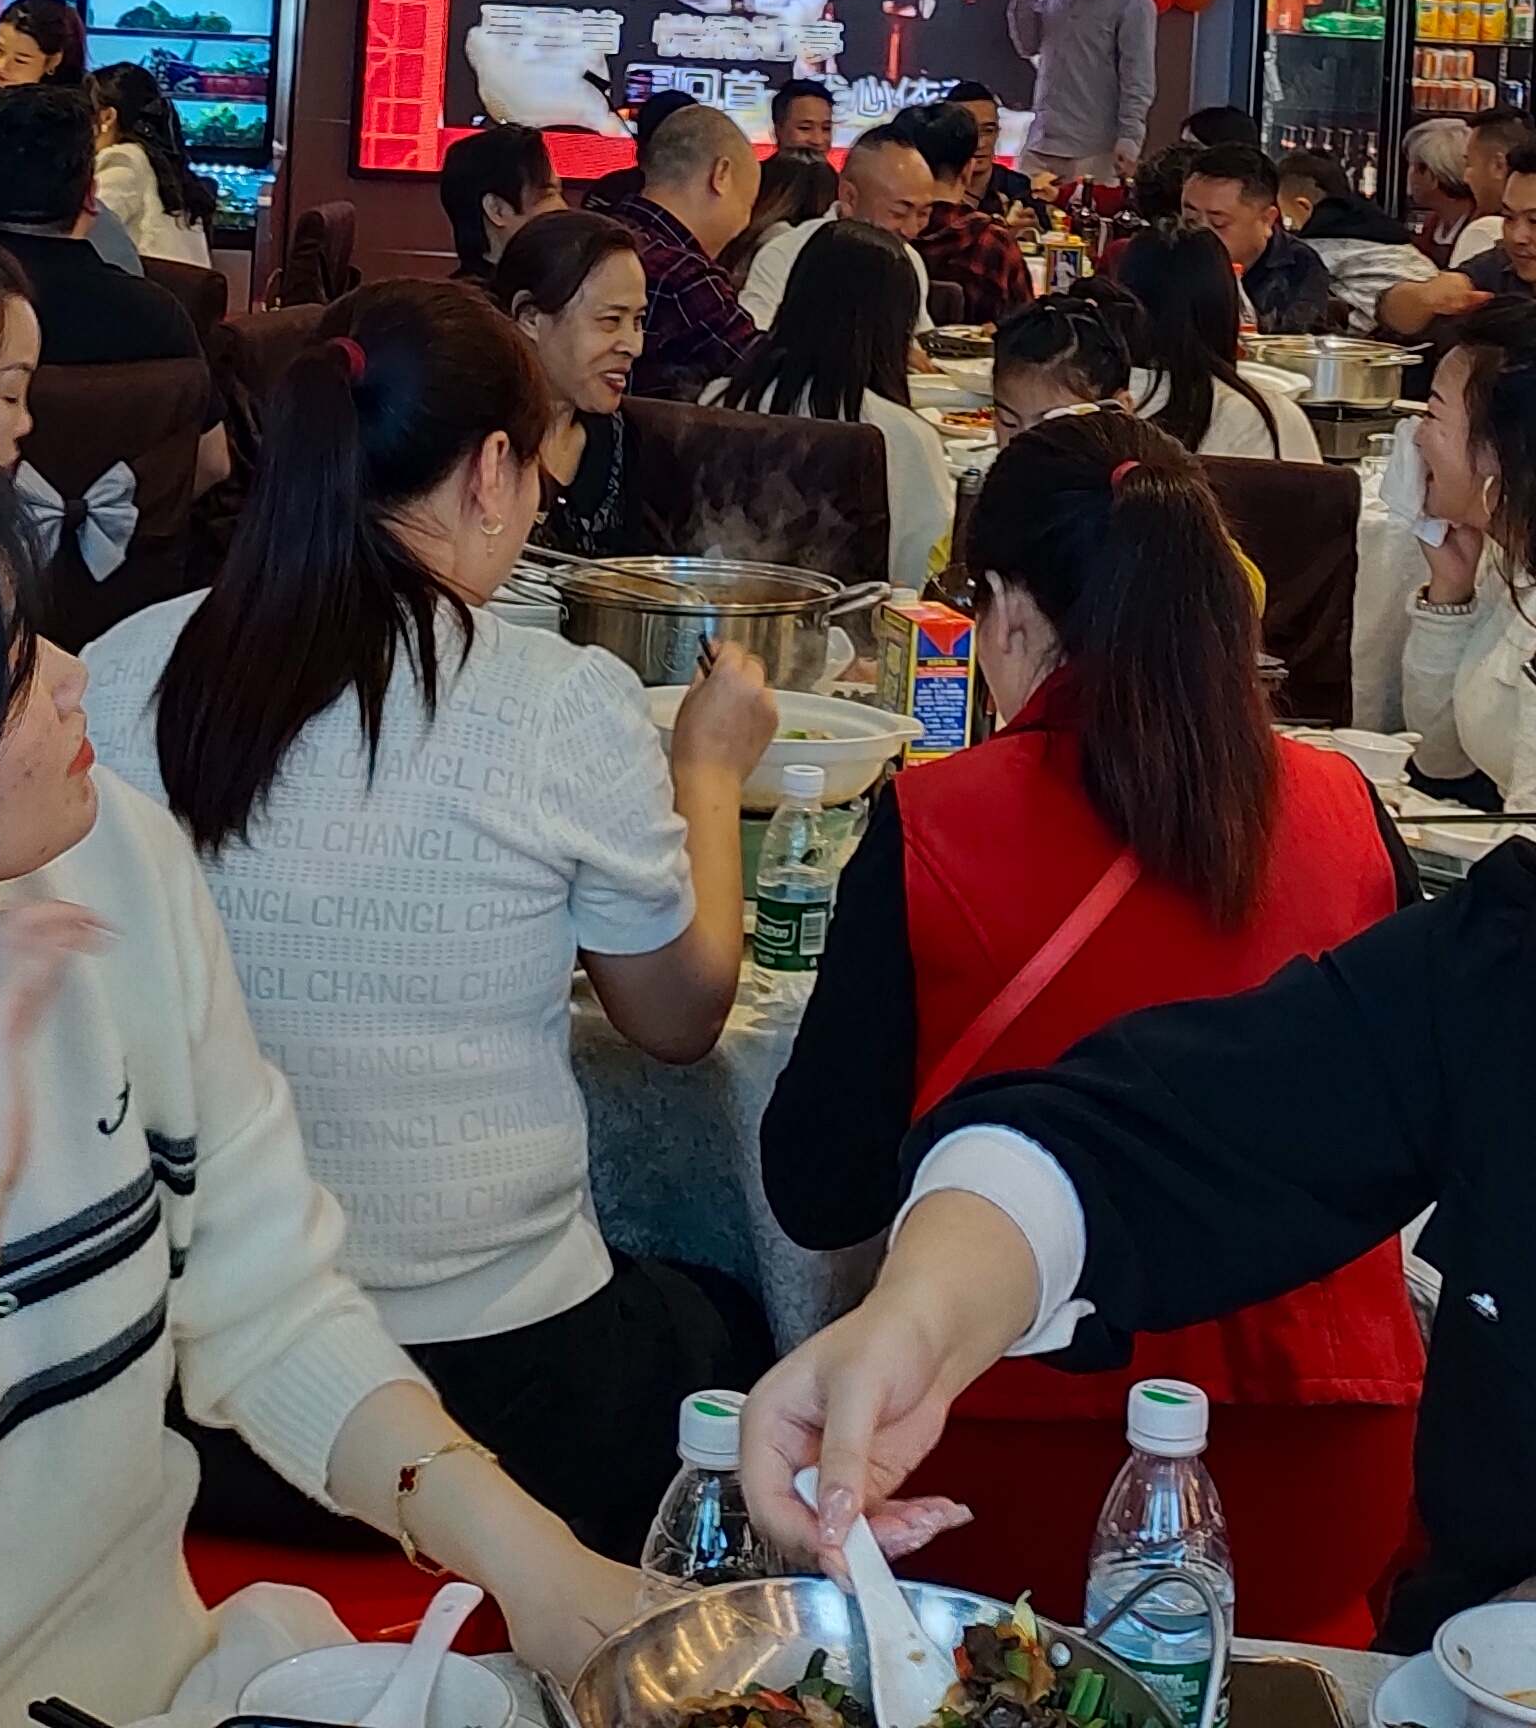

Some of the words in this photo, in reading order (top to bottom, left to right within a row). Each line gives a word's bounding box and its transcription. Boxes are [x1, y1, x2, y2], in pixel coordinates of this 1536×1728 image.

[322, 820, 463, 862] CHANGL
[311, 894, 457, 934] CHANGL
[306, 969, 450, 1005] CHANGL
[306, 1043, 450, 1078] CHANGL
[314, 1114, 452, 1151] CHANGL
[338, 1189, 458, 1225] HANGL
